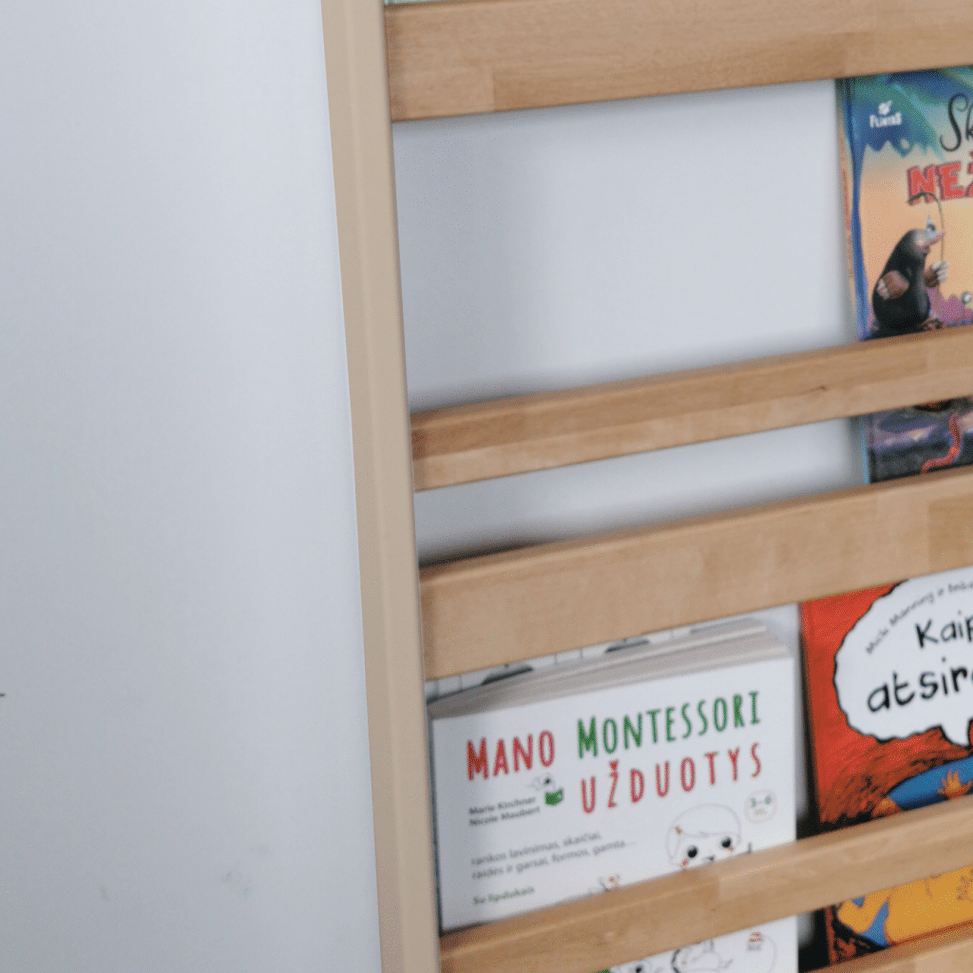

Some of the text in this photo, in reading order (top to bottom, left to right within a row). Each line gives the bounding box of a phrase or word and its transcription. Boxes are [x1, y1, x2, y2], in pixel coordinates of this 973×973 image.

[467, 691, 760, 780] MANO MONTESSORI
[581, 742, 761, 814] UŽDUOTYS
